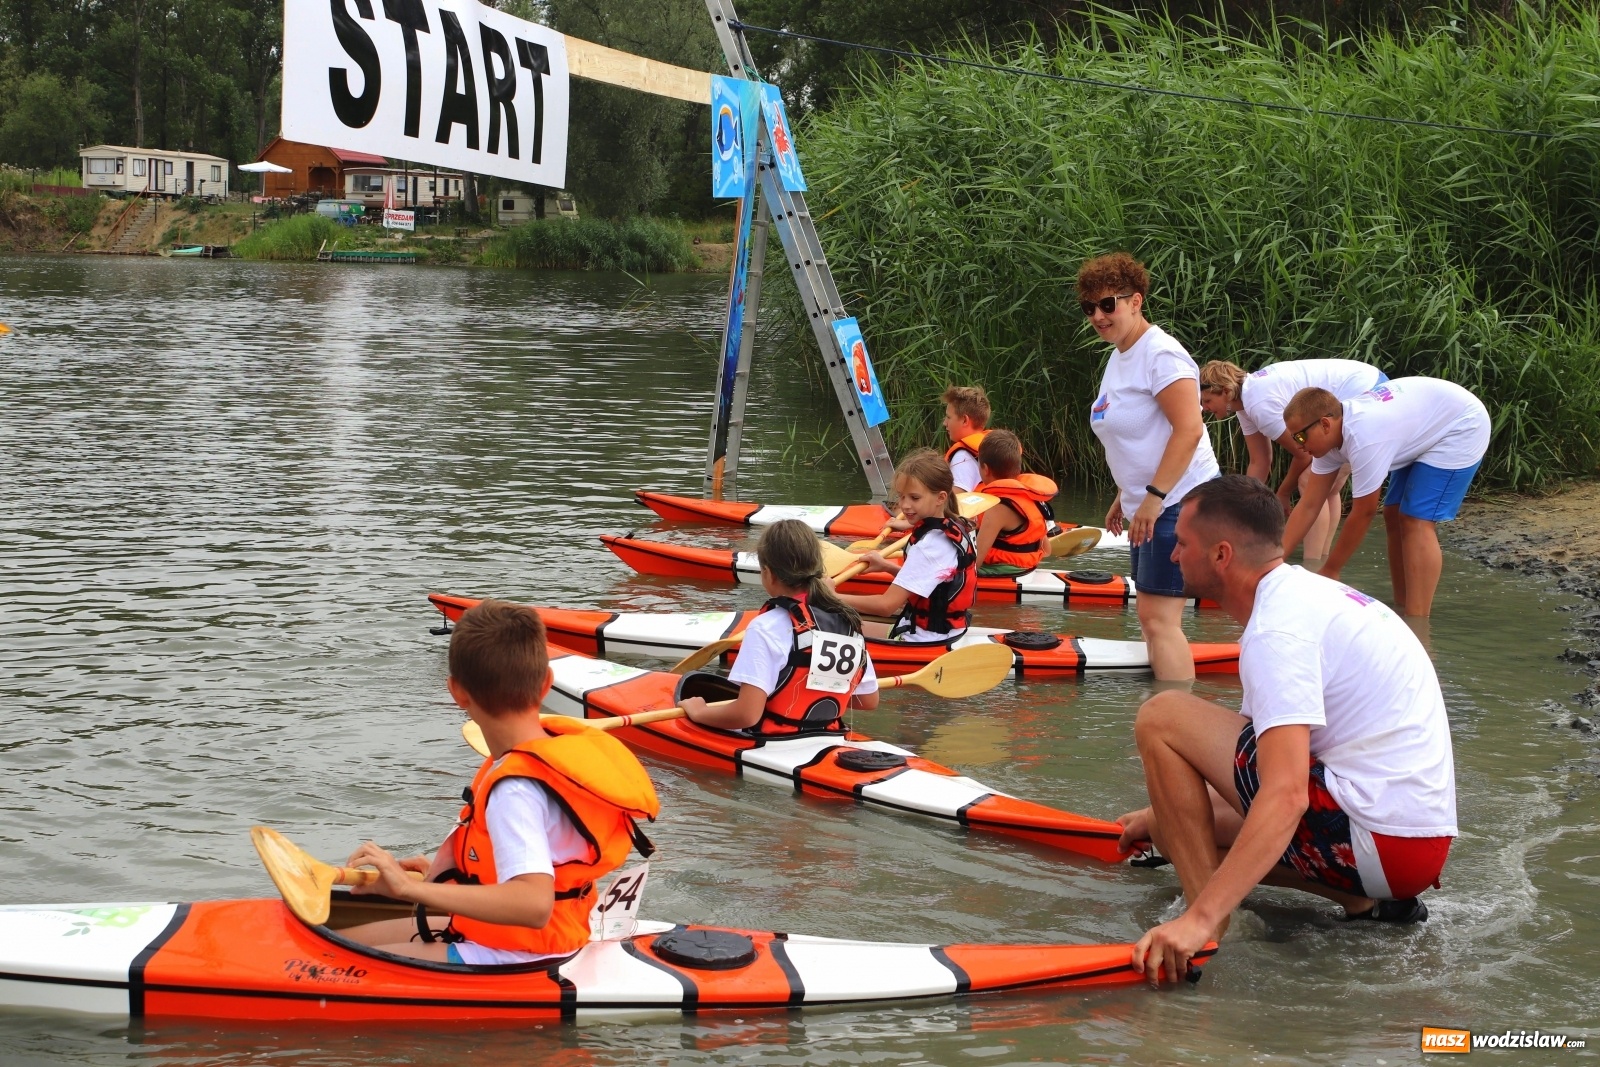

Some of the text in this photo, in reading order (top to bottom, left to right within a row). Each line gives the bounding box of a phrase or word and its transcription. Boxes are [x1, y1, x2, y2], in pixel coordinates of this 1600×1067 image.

[329, 0, 550, 164] START
[385, 213, 413, 222] SPRZEDAM
[817, 640, 856, 675] 58
[597, 872, 645, 912] 54
